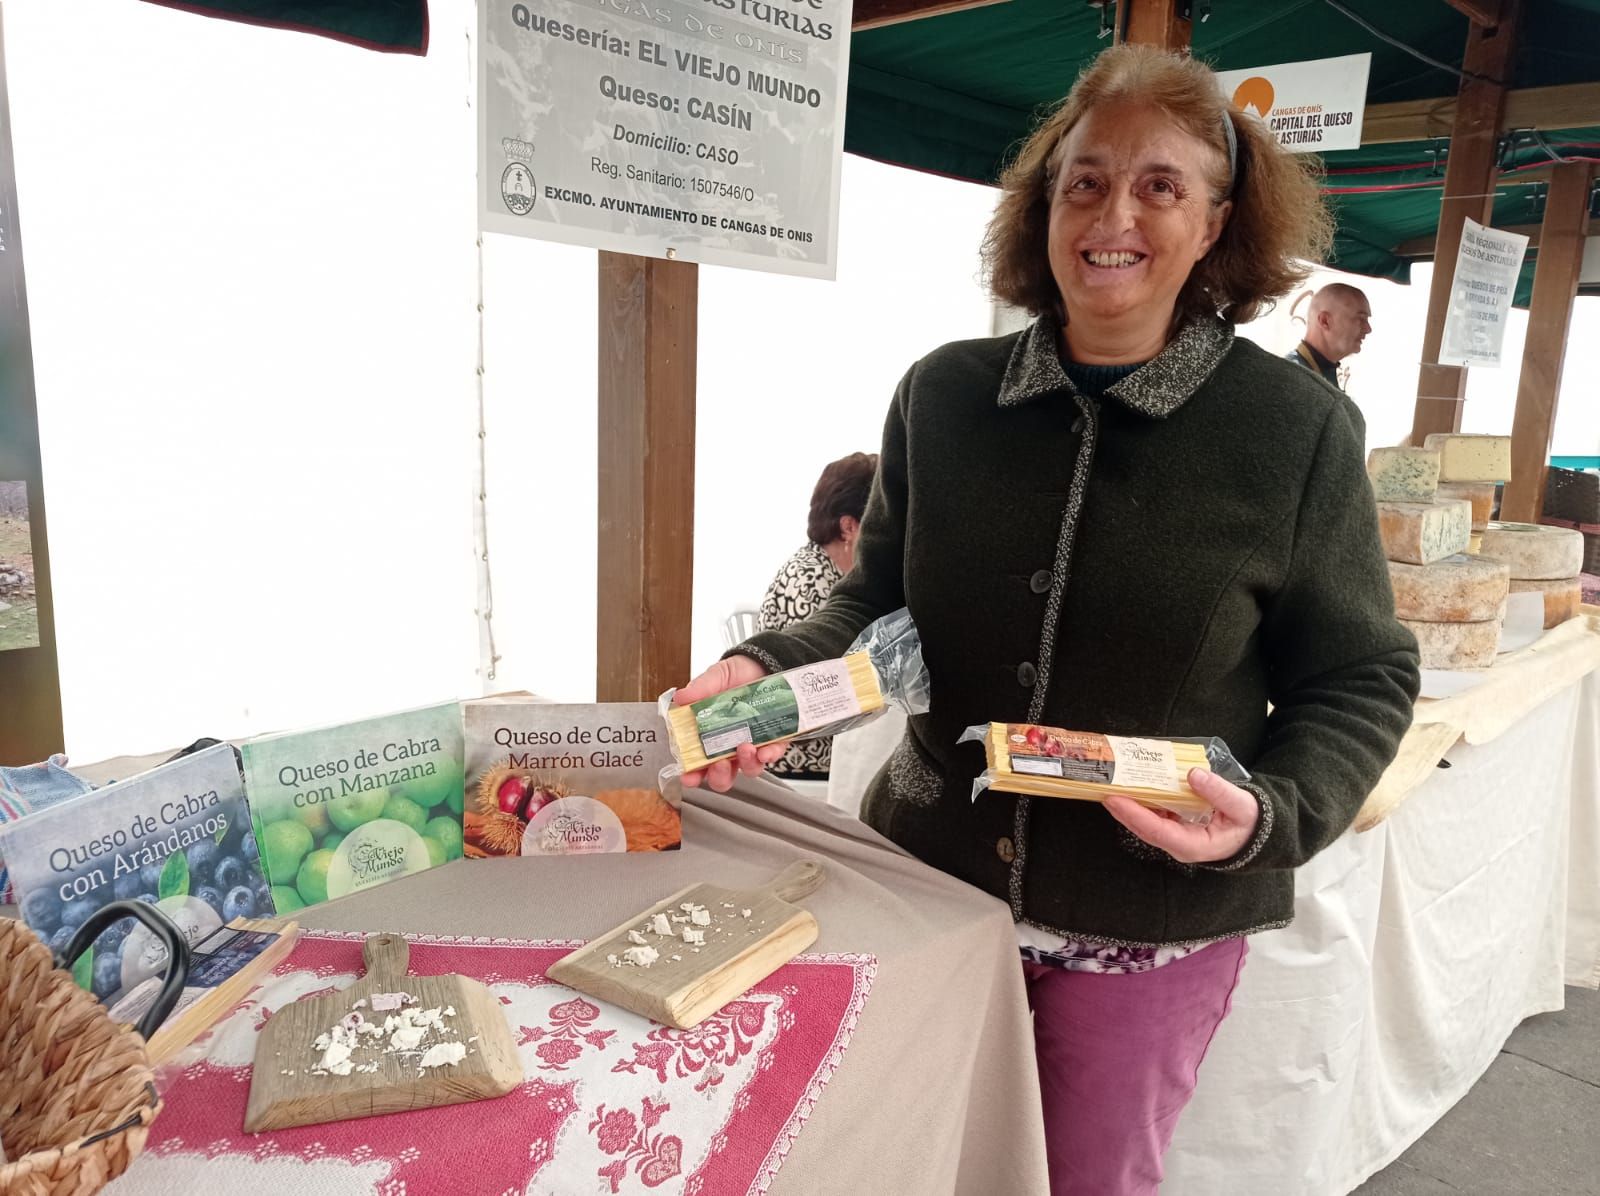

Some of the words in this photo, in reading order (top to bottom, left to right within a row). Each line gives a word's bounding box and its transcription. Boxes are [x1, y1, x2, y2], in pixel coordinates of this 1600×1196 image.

[685, 13, 724, 39] DE
[704, 0, 833, 41] STURIAS
[511, 3, 630, 57] Quesería:
[638, 39, 668, 67] EL
[675, 49, 741, 86] VIEJO
[747, 71, 821, 108] MUNDO
[600, 75, 680, 114] Queso:
[687, 97, 752, 131] CASÍN
[1272, 108, 1296, 116] CANGAS
[1297, 106, 1307, 114] DE
[1271, 117, 1303, 130] CAPITAL
[1306, 114, 1322, 128] DEL
[1324, 112, 1352, 126] QUESO
[1280, 131, 1322, 144] ASTURIAS
[613, 124, 692, 155] Domicilio:
[696, 143, 739, 165] CASO
[591, 157, 622, 179] Reg.
[626, 164, 686, 189] Sanitario:
[690, 177, 754, 202] 1507546/O
[544, 185, 596, 207] EXCMO.
[600, 197, 698, 224] AYUNTAMIENTO
[701, 215, 717, 227] DE
[720, 218, 767, 236] CANGAS
[770, 226, 784, 239] DE
[787, 229, 813, 243] ONIS
[493, 726, 562, 748] Queso
[567, 727, 592, 746] de
[596, 725, 657, 746] Cabra
[278, 758, 350, 789] Queso
[354, 747, 379, 770] de
[383, 733, 441, 763] Cabra
[508, 749, 585, 770] Marrón
[590, 749, 644, 769] Glacé
[293, 785, 336, 809] con
[340, 757, 437, 798] Manzana
[49, 824, 127, 874] Queso
[131, 814, 158, 840] de
[160, 788, 220, 828] Cabra
[560, 831, 600, 843] Mundo
[572, 820, 602, 834] Viejo
[58, 866, 108, 903] con
[112, 811, 228, 880] Arándanos
[367, 857, 404, 873] Mundo
[374, 846, 404, 861] Viejo
